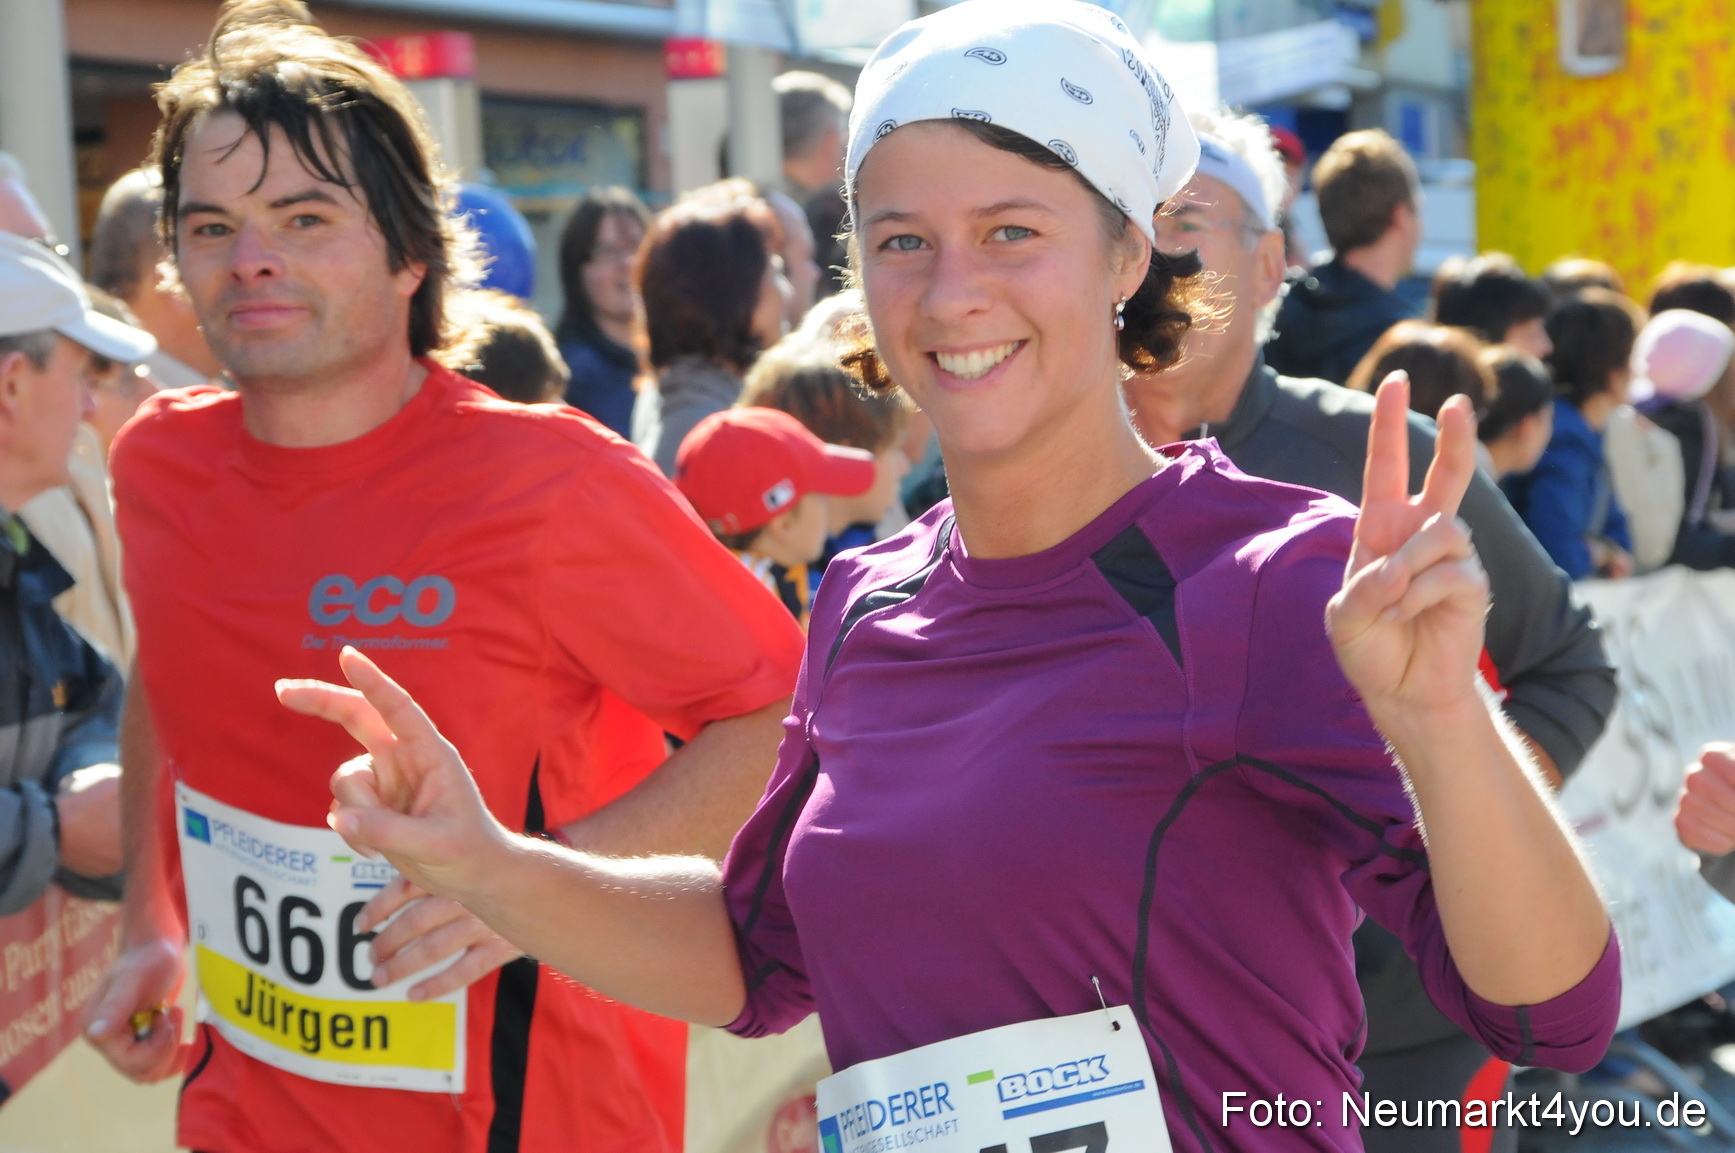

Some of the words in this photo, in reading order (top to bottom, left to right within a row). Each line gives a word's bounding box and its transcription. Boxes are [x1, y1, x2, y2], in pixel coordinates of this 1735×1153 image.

[308, 573, 456, 628] eco
[301, 633, 327, 650] Der
[211, 818, 318, 874] PFLEIDERER
[233, 874, 380, 993] 666
[234, 971, 389, 1055] Jürgen
[997, 1054, 1111, 1104] BOCK
